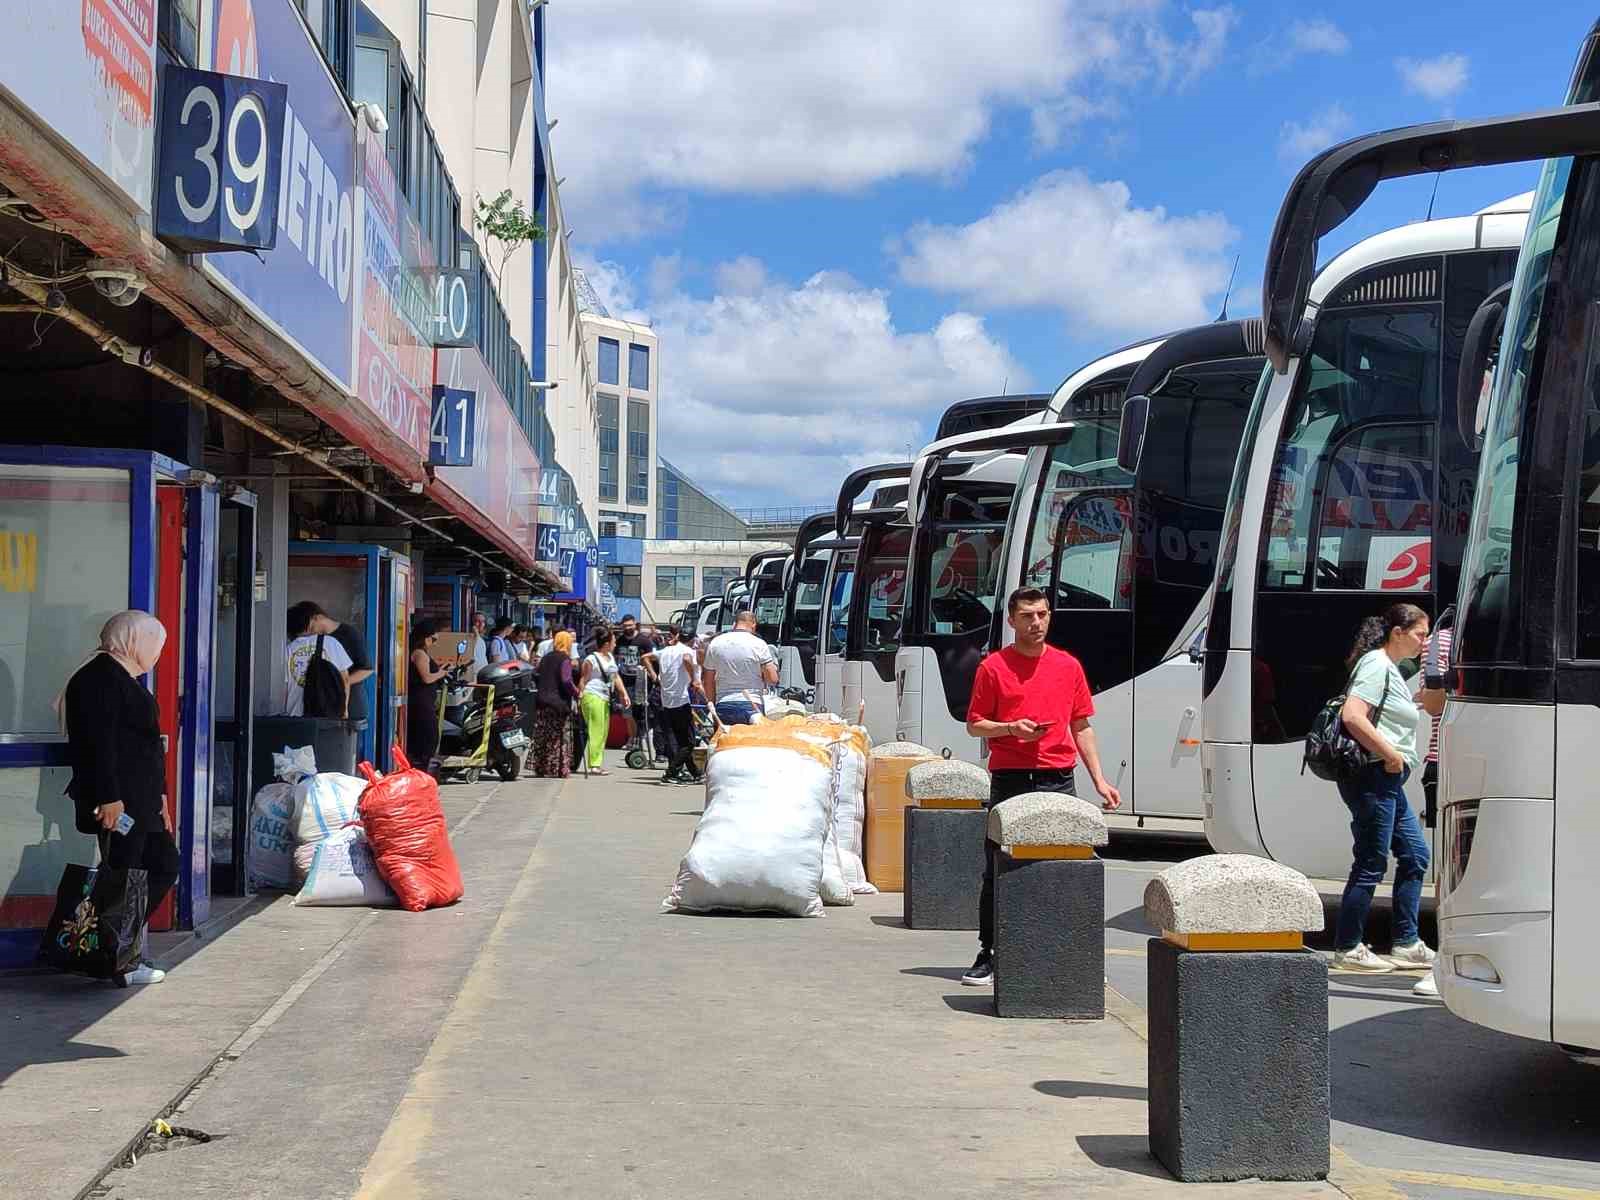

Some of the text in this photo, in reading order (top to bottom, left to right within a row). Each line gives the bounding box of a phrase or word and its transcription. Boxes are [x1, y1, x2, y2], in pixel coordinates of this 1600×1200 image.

[175, 85, 268, 231] 39
[432, 274, 468, 338] 40
[431, 396, 468, 458] 41
[538, 471, 558, 502] 44
[559, 507, 575, 531] 46
[538, 526, 558, 558] 45
[574, 530, 586, 551] 48
[560, 551, 575, 575] 47
[586, 548, 597, 565] 49
